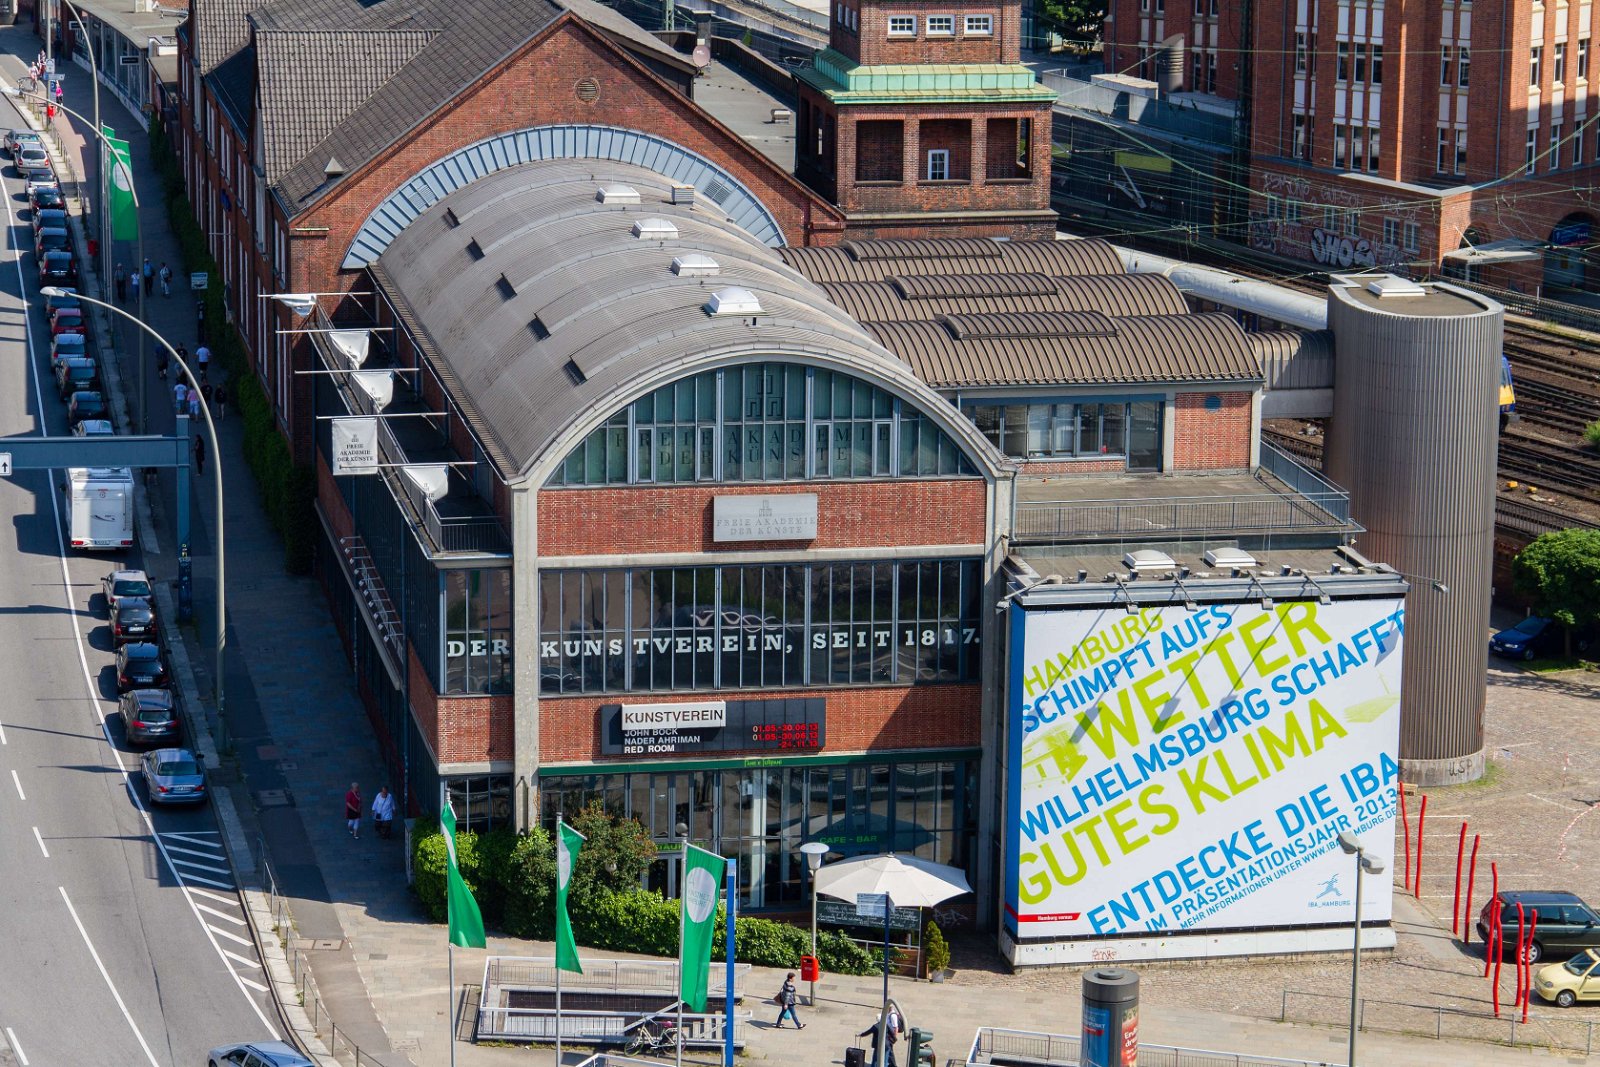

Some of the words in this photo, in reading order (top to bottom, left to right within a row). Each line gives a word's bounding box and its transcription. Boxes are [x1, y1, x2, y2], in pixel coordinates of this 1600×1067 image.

[615, 431, 713, 447] FREIE
[727, 427, 889, 445] AKADEMIE
[660, 450, 713, 465] DER
[728, 446, 848, 465] KÜNSTE
[716, 519, 752, 527] FREIE
[755, 517, 816, 526] AKADEMIE
[730, 528, 753, 536] DER
[447, 638, 510, 657] DER
[541, 633, 794, 658] KUNSTVEREIN,
[812, 630, 890, 650] SEIT
[905, 628, 980, 646] 1817.
[1023, 607, 1164, 698] HAMBURG
[1022, 639, 1156, 733] SCHIMPFT
[1160, 604, 1233, 660] AUFS
[1073, 601, 1333, 760] WETTER
[624, 709, 723, 724] KUNSTVEREIN
[1019, 687, 1270, 842] WILHELMSBURG
[1271, 609, 1404, 706] SCHAFFT
[624, 728, 650, 737] JOHN
[652, 727, 678, 736] BOCK
[624, 737, 655, 746] NADER
[657, 735, 700, 744] AHRIMAN
[624, 746, 644, 754] RED
[648, 745, 675, 753] ROOM
[1018, 784, 1180, 905] GUTES
[1177, 698, 1348, 815] KLIMA
[819, 836, 847, 844] CAFE
[857, 835, 878, 843] BAR
[1086, 819, 1273, 935] ENTDECKE
[1275, 783, 1339, 838] DIE
[1340, 751, 1399, 804] IBA
[1145, 912, 1168, 932] IM
[1171, 814, 1352, 921] PRÄSENTATIONSJAHR
[1354, 787, 1397, 822] 2013
[1180, 911, 1207, 930] MEHR
[1206, 874, 1274, 916] INFORMATIONEN
[1273, 859, 1303, 879] UNTER
